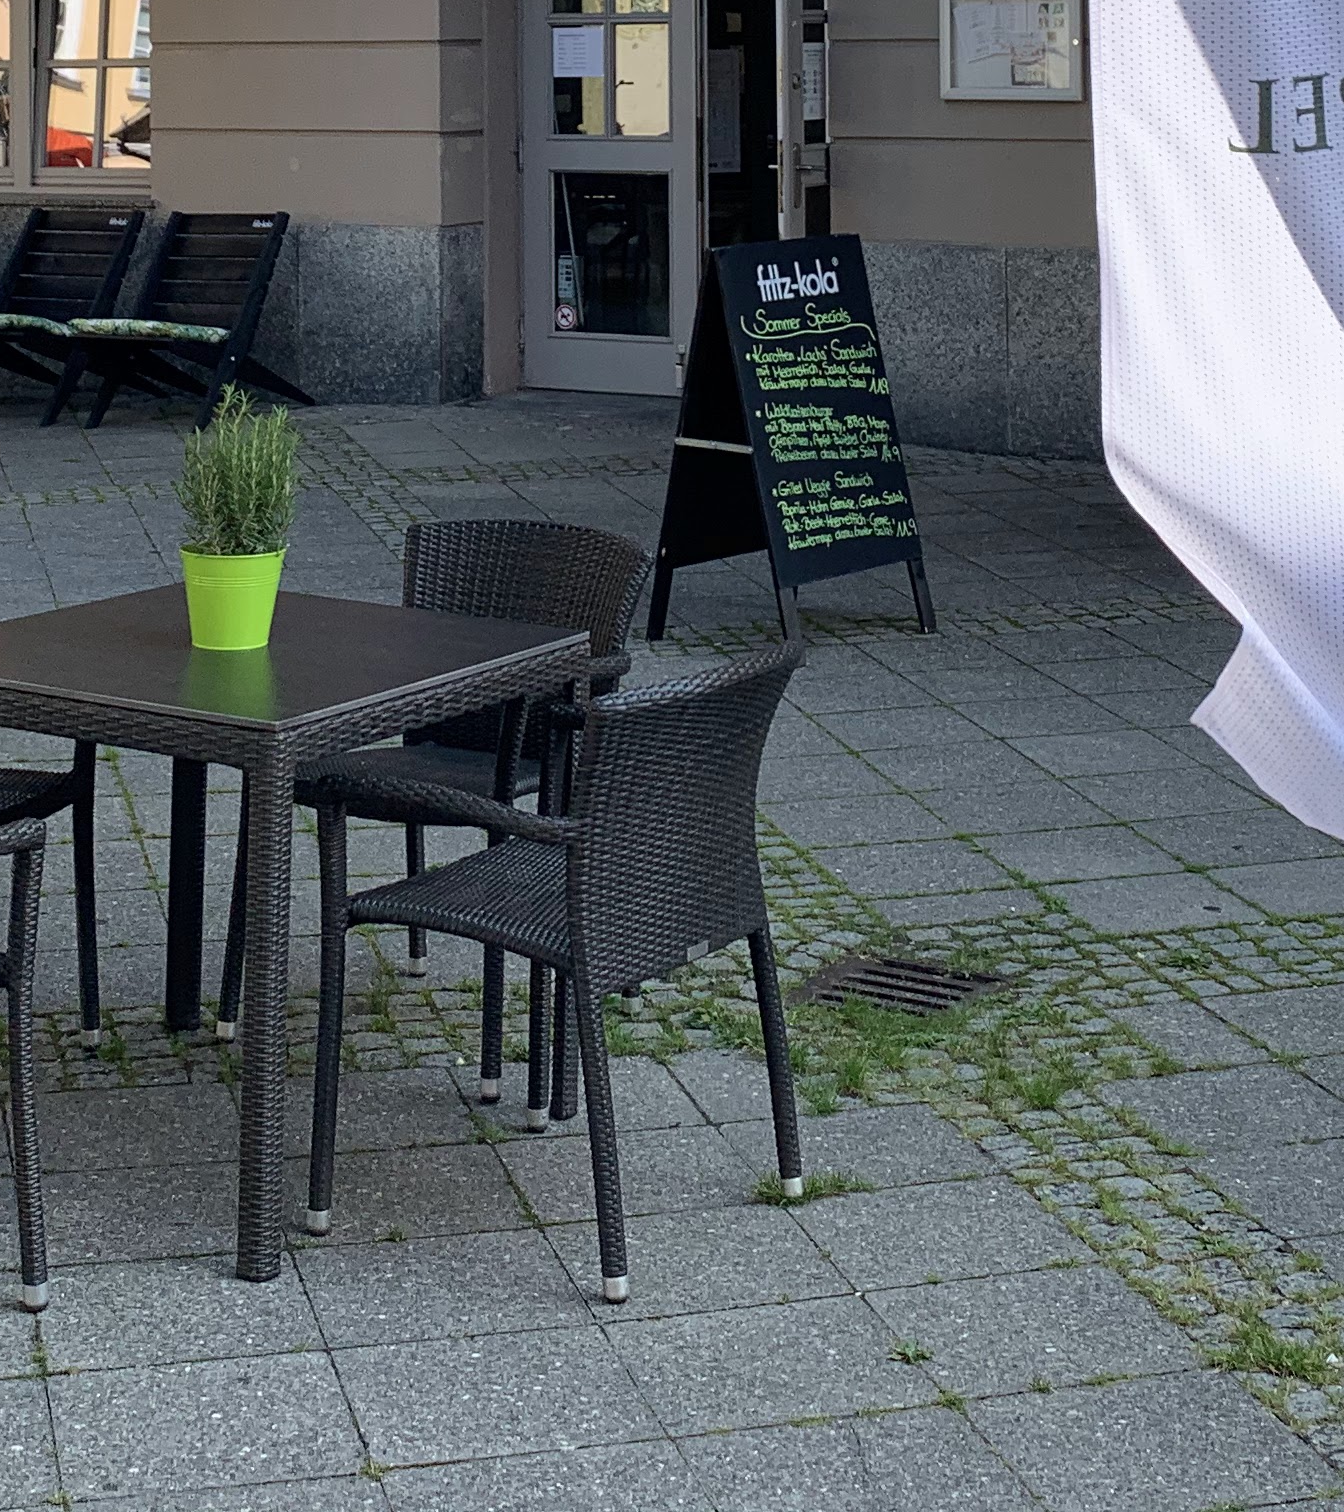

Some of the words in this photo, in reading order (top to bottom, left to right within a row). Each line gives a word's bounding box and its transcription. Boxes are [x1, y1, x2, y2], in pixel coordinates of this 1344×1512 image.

[805, 303, 851, 331] Specials
[830, 339, 877, 360] Sandwich
[834, 471, 874, 488] Sandwich
